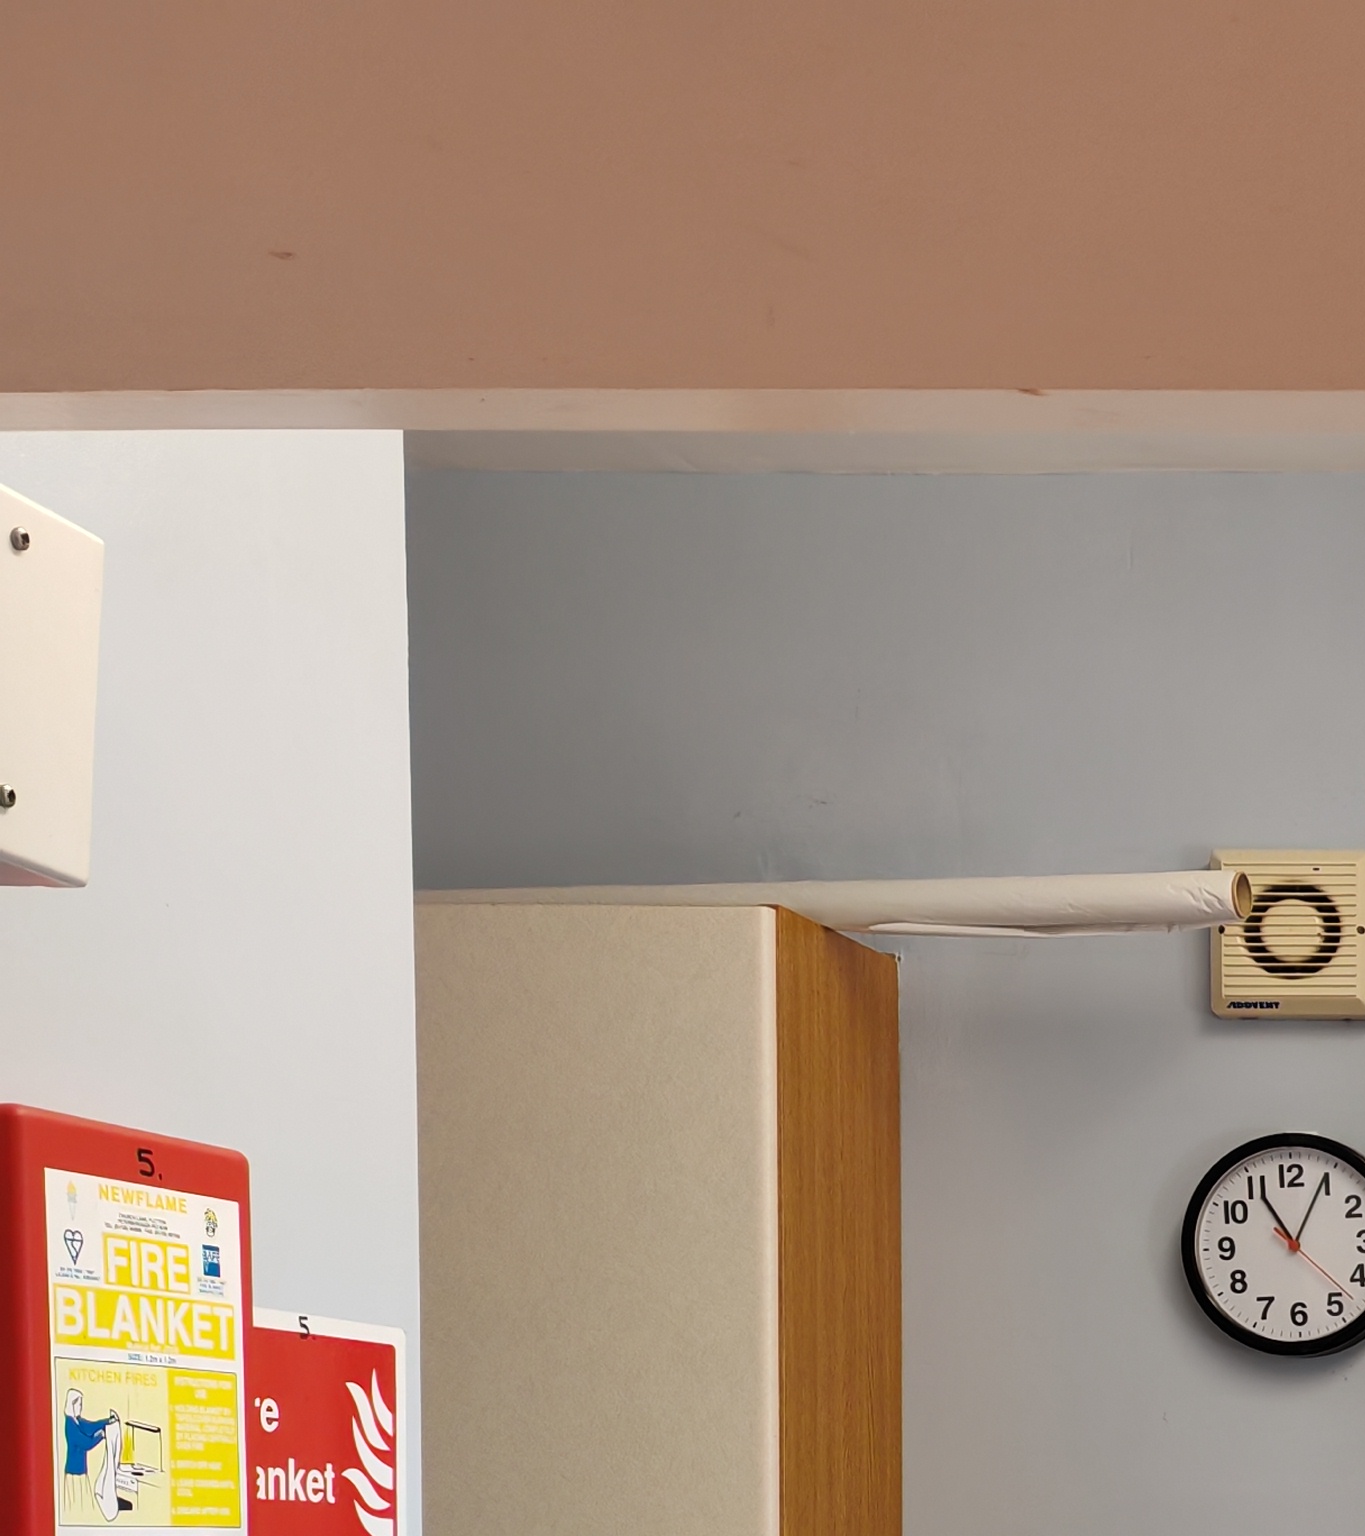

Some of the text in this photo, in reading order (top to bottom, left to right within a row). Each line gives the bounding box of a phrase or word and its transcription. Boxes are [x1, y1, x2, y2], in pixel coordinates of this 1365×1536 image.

[1278, 1164, 1305, 1188] 12
[98, 1184, 188, 1214] NEWFLAME
[1344, 1195, 1363, 1218] 2
[1223, 1200, 1248, 1224] 10
[1217, 1236, 1236, 1261] 9
[106, 1236, 190, 1293] FIRE
[1230, 1269, 1248, 1294] 8
[1256, 1296, 1275, 1320] 7
[1290, 1302, 1308, 1326] 6
[1326, 1292, 1344, 1316] 5
[55, 1288, 234, 1352] BLANKET
[69, 1368, 121, 1383] KITCHEN
[126, 1371, 157, 1387] FIRES
